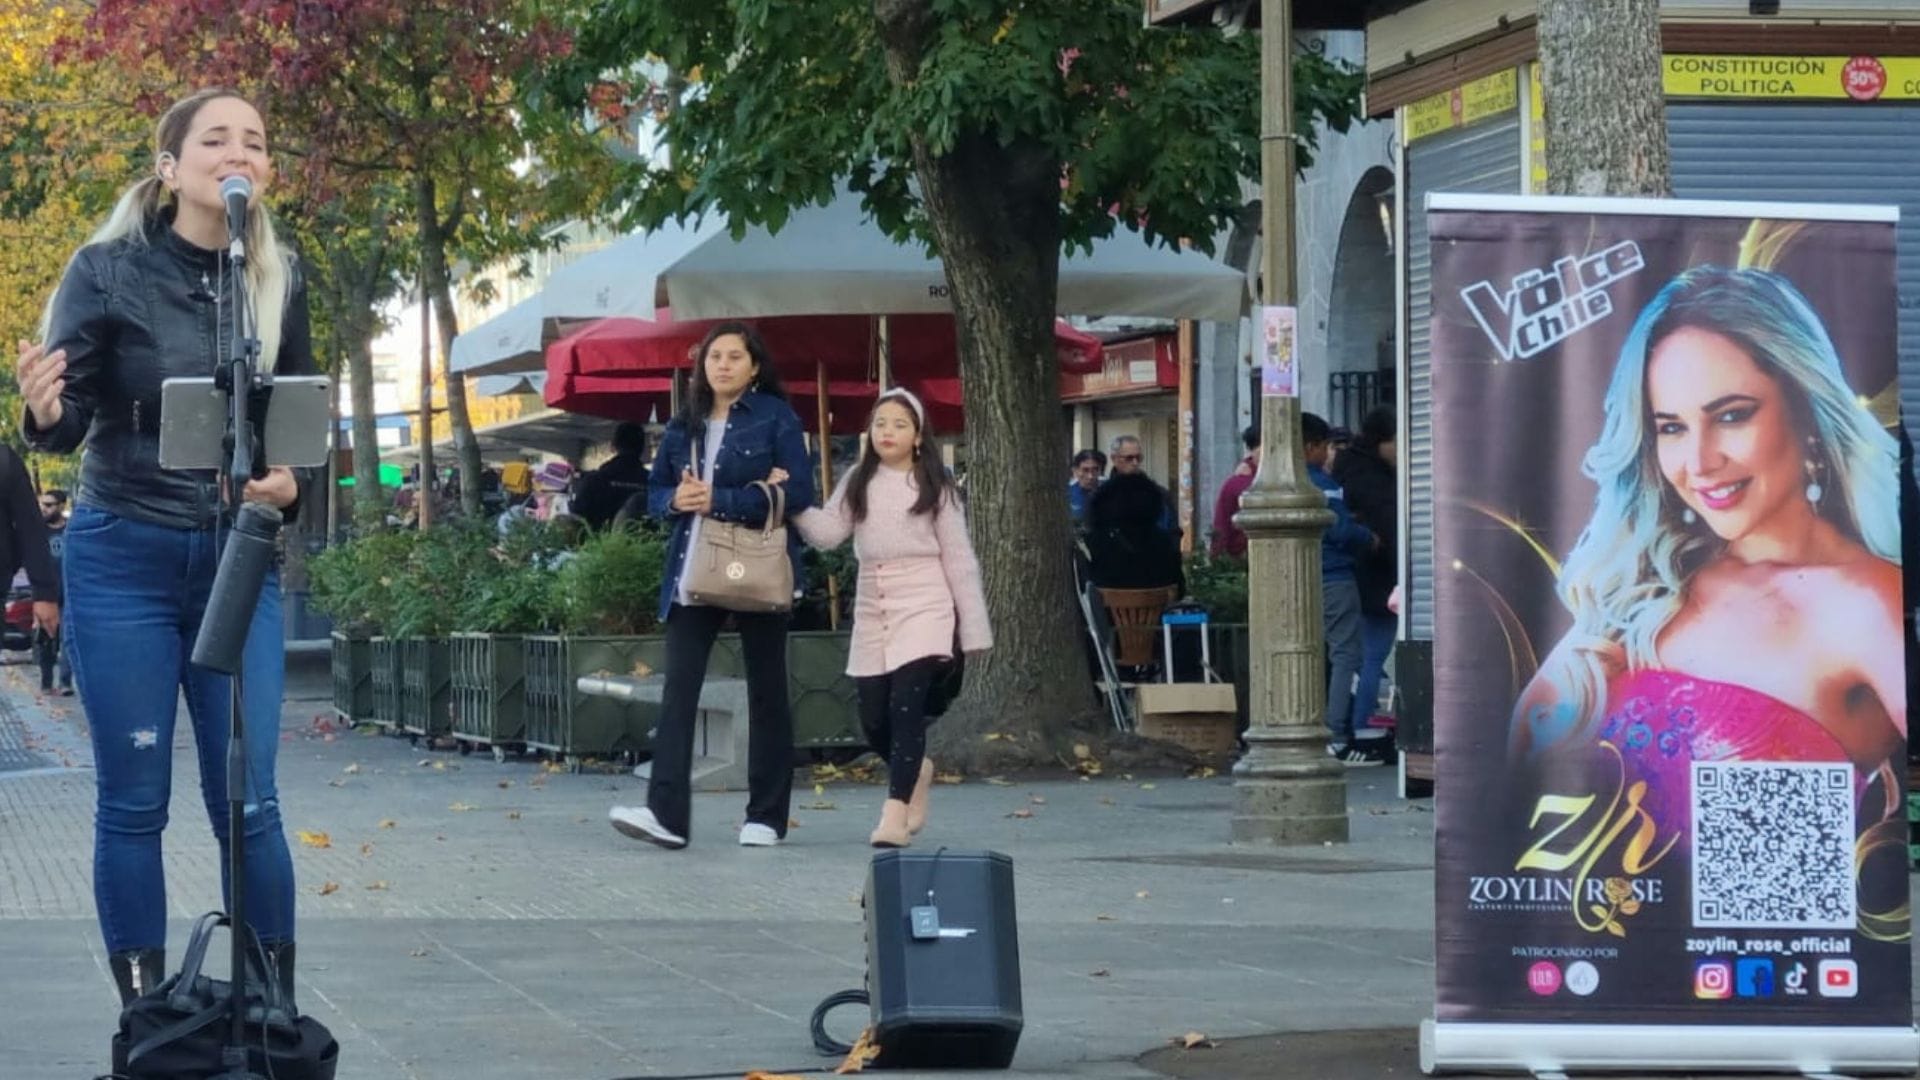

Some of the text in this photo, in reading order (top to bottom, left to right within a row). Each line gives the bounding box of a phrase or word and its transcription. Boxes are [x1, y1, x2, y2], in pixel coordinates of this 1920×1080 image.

[1670, 57, 1825, 74] CONSTITUCIÓN
[1700, 79, 1795, 93] POLITICA
[1849, 71, 1880, 86] 50%
[928, 285, 949, 297] RO
[1515, 290, 1613, 358] Chile
[1469, 877, 1572, 903] ZOYLIN
[1512, 947, 1618, 958] PATROCINADO POR
[1686, 937, 1851, 955] zoylin_rose_official
